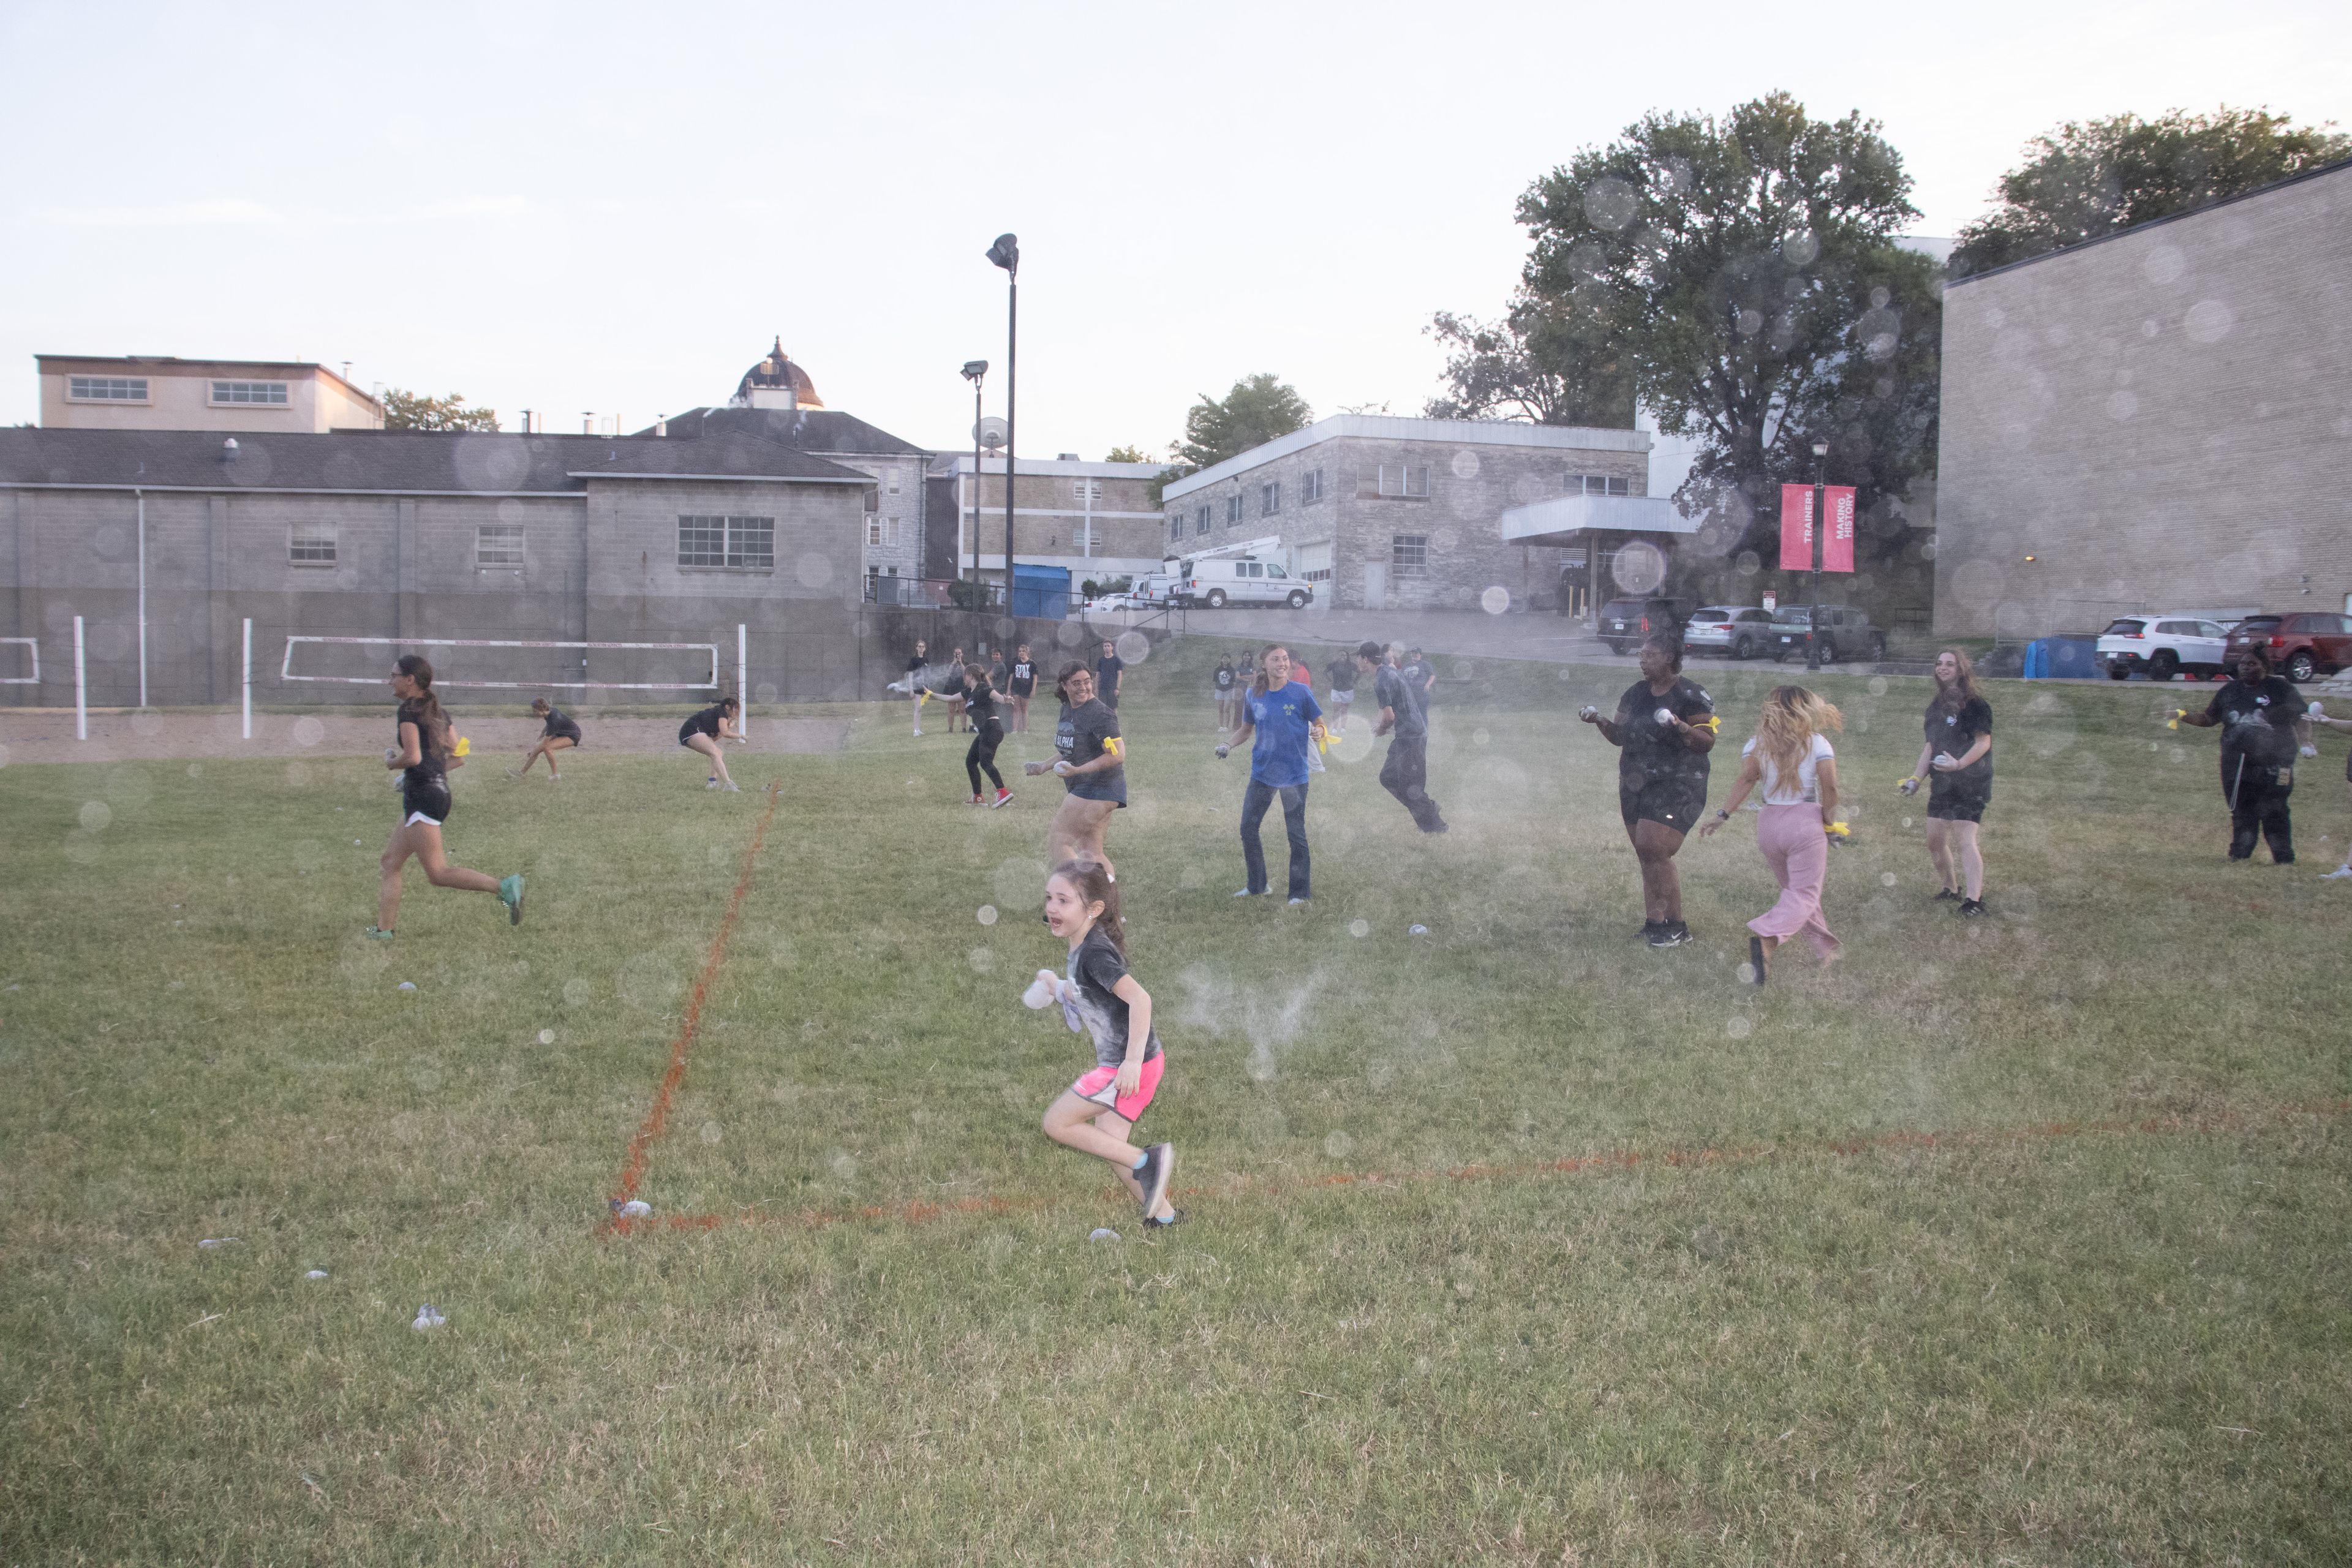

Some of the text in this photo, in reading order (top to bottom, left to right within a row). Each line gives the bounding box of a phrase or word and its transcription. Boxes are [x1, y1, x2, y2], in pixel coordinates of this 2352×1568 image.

[1804, 490, 1813, 543] TRAINERS
[1836, 497, 1846, 539] MAKING
[1844, 493, 1853, 538] HISTORY
[1057, 735, 1074, 748] ALPHA
